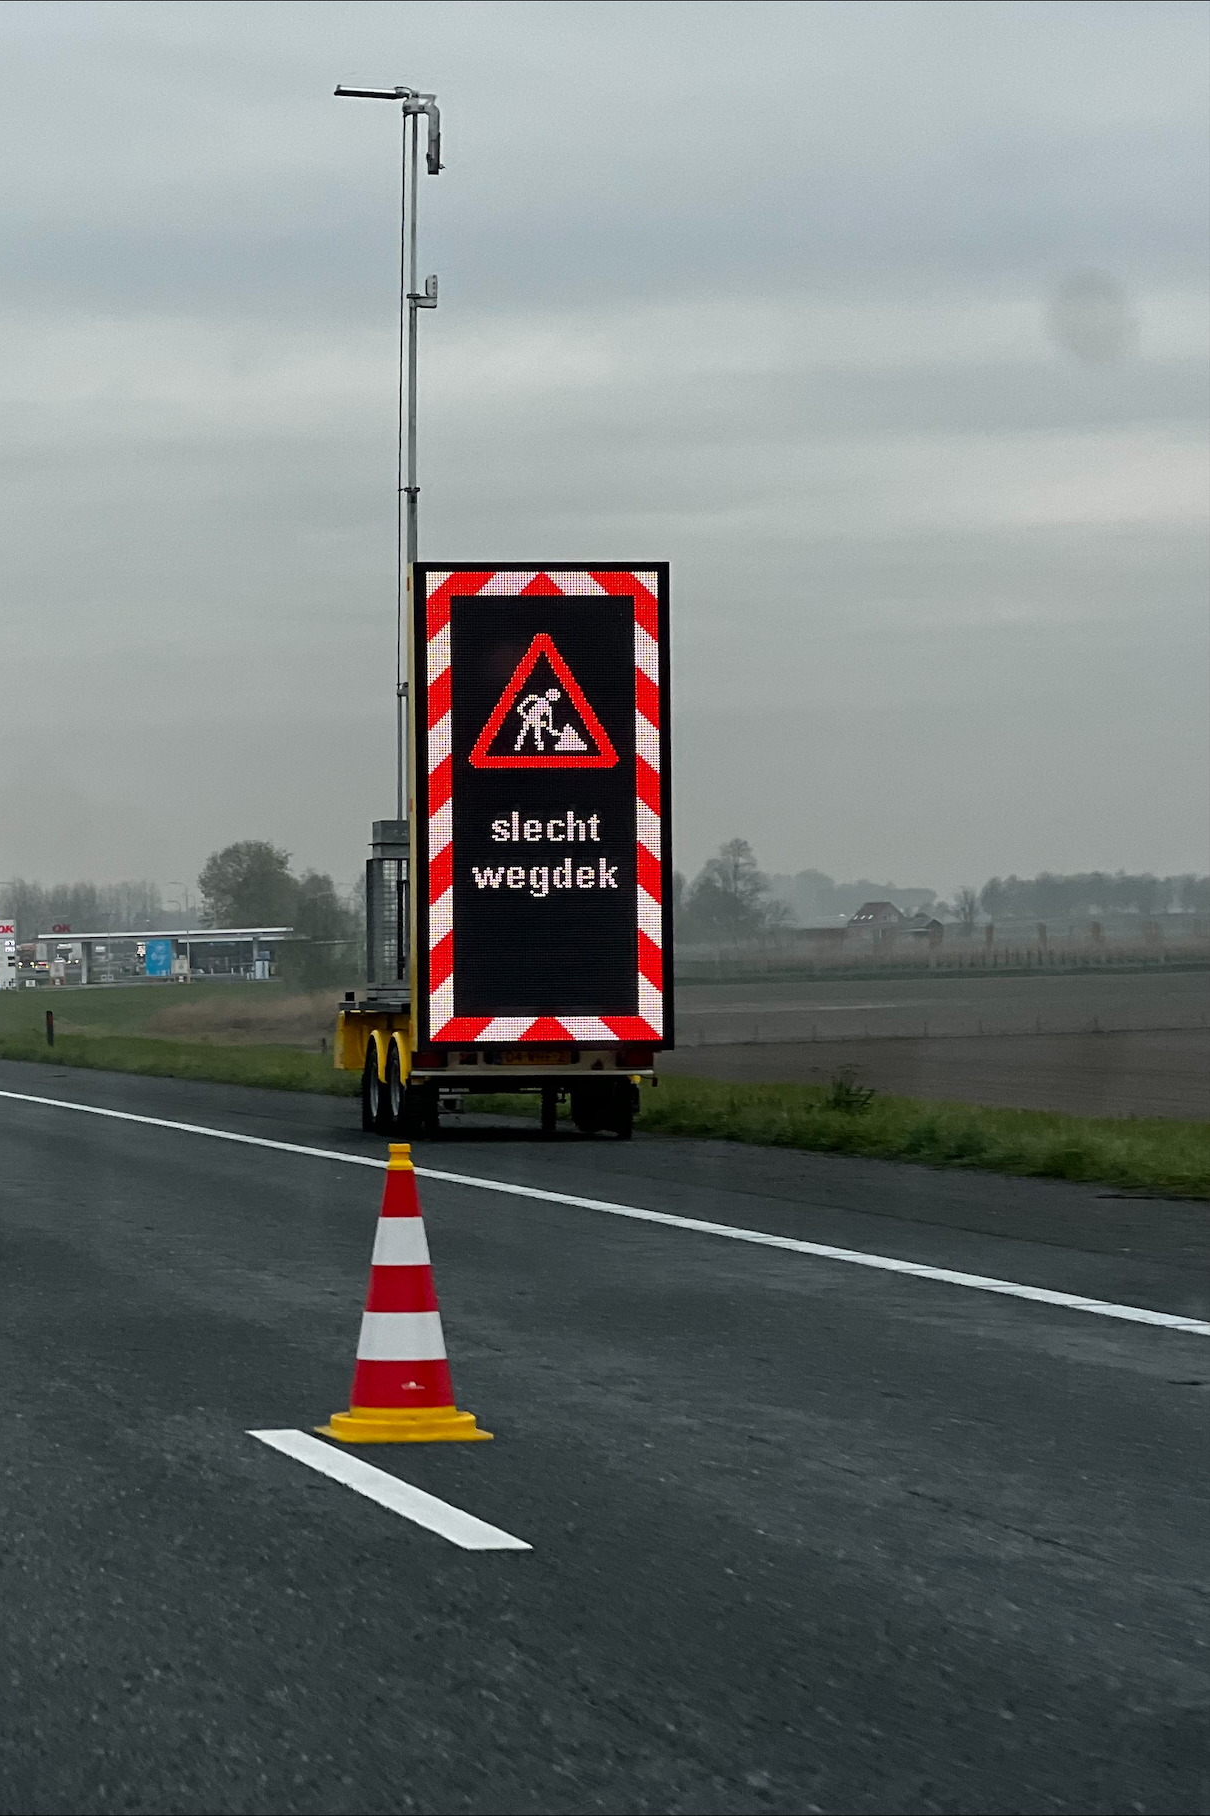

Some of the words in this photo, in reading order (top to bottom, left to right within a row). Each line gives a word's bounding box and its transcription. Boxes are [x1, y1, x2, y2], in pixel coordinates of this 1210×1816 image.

[491, 811, 601, 842] slecht
[472, 857, 619, 897] wegdek
[52, 924, 71, 933] OK
